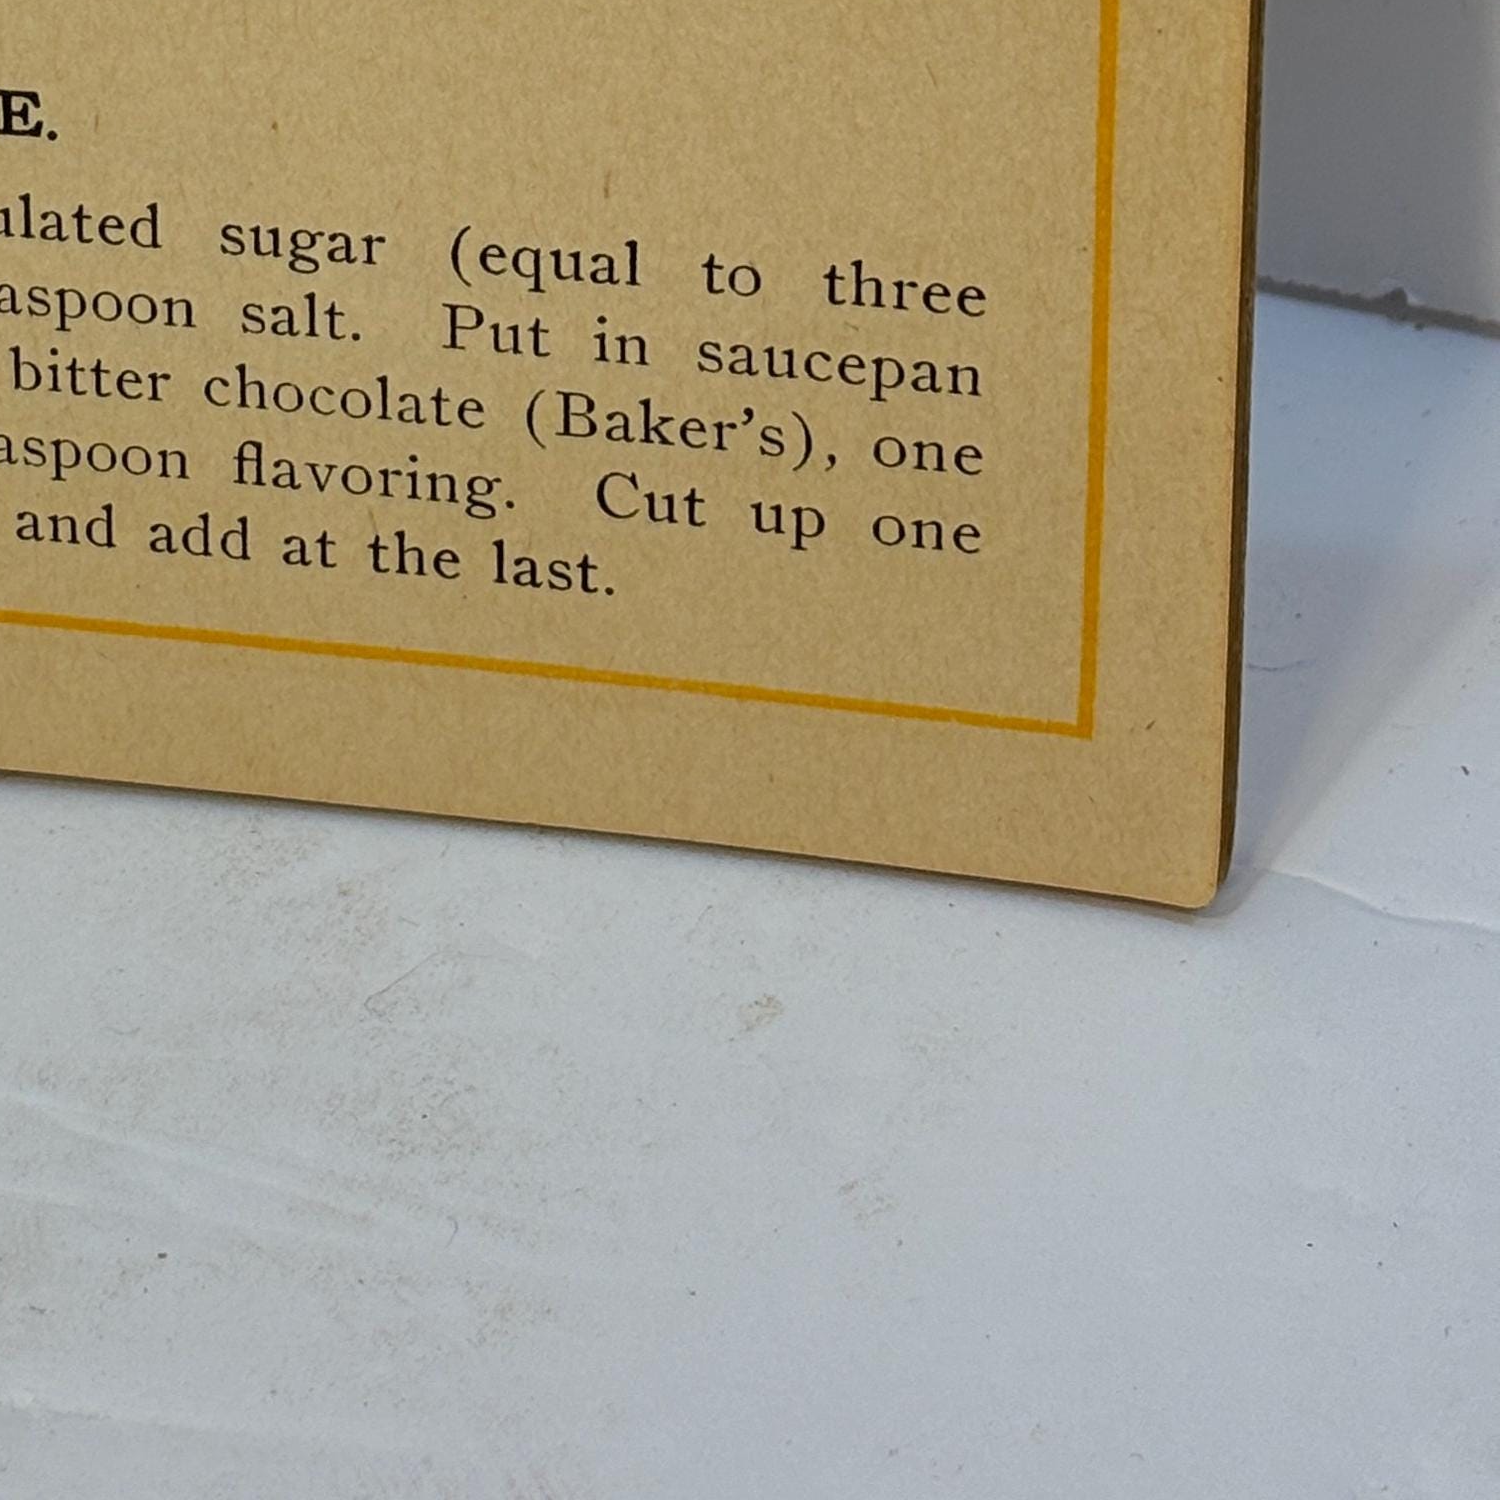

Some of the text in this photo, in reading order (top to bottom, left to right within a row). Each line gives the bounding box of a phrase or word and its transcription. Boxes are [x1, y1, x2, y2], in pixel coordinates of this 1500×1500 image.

[219, 223, 387, 275] sugar
[450, 225, 641, 294] (equal
[701, 252, 762, 298] to
[822, 259, 987, 318] three
[241, 291, 361, 342] salt.
[441, 302, 551, 358] Put
[593, 315, 650, 366] in
[697, 340, 982, 403] saucepan
[8, 345, 172, 402] bitter
[203, 362, 485, 430] chocolate
[872, 436, 983, 476] one
[15, 502, 117, 549] and
[148, 511, 252, 561] add
[282, 530, 338, 569] at
[366, 529, 461, 580] the
[491, 538, 615, 597] last.
[232, 439, 515, 520] flavoring.
[596, 471, 707, 528] Cut
[749, 501, 826, 552] up
[872, 515, 981, 555] one
